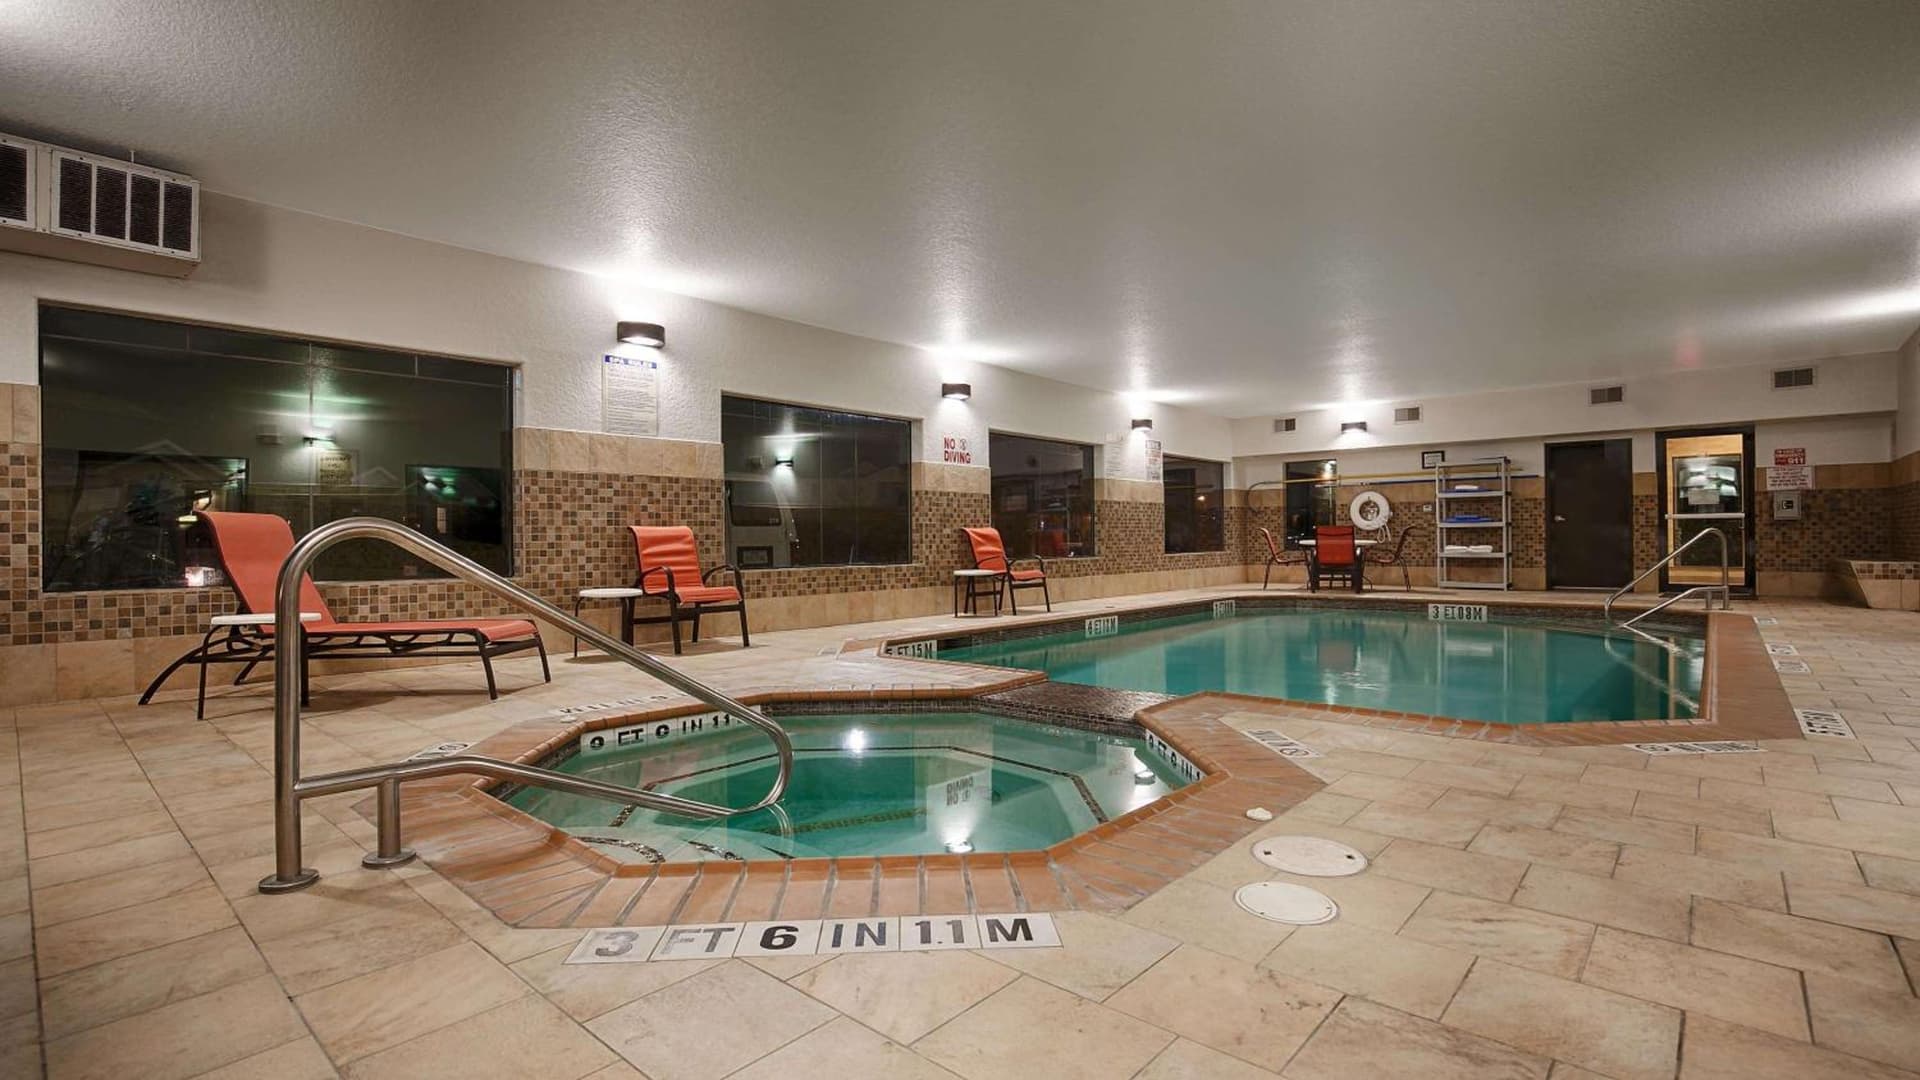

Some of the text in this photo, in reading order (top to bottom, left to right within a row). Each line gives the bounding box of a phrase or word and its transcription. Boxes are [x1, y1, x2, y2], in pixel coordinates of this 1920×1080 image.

[944, 437, 956, 450] NO
[944, 450, 971, 464] DIVING
[595, 918, 1033, 957] 3 FT 6 IN 1.1 M
